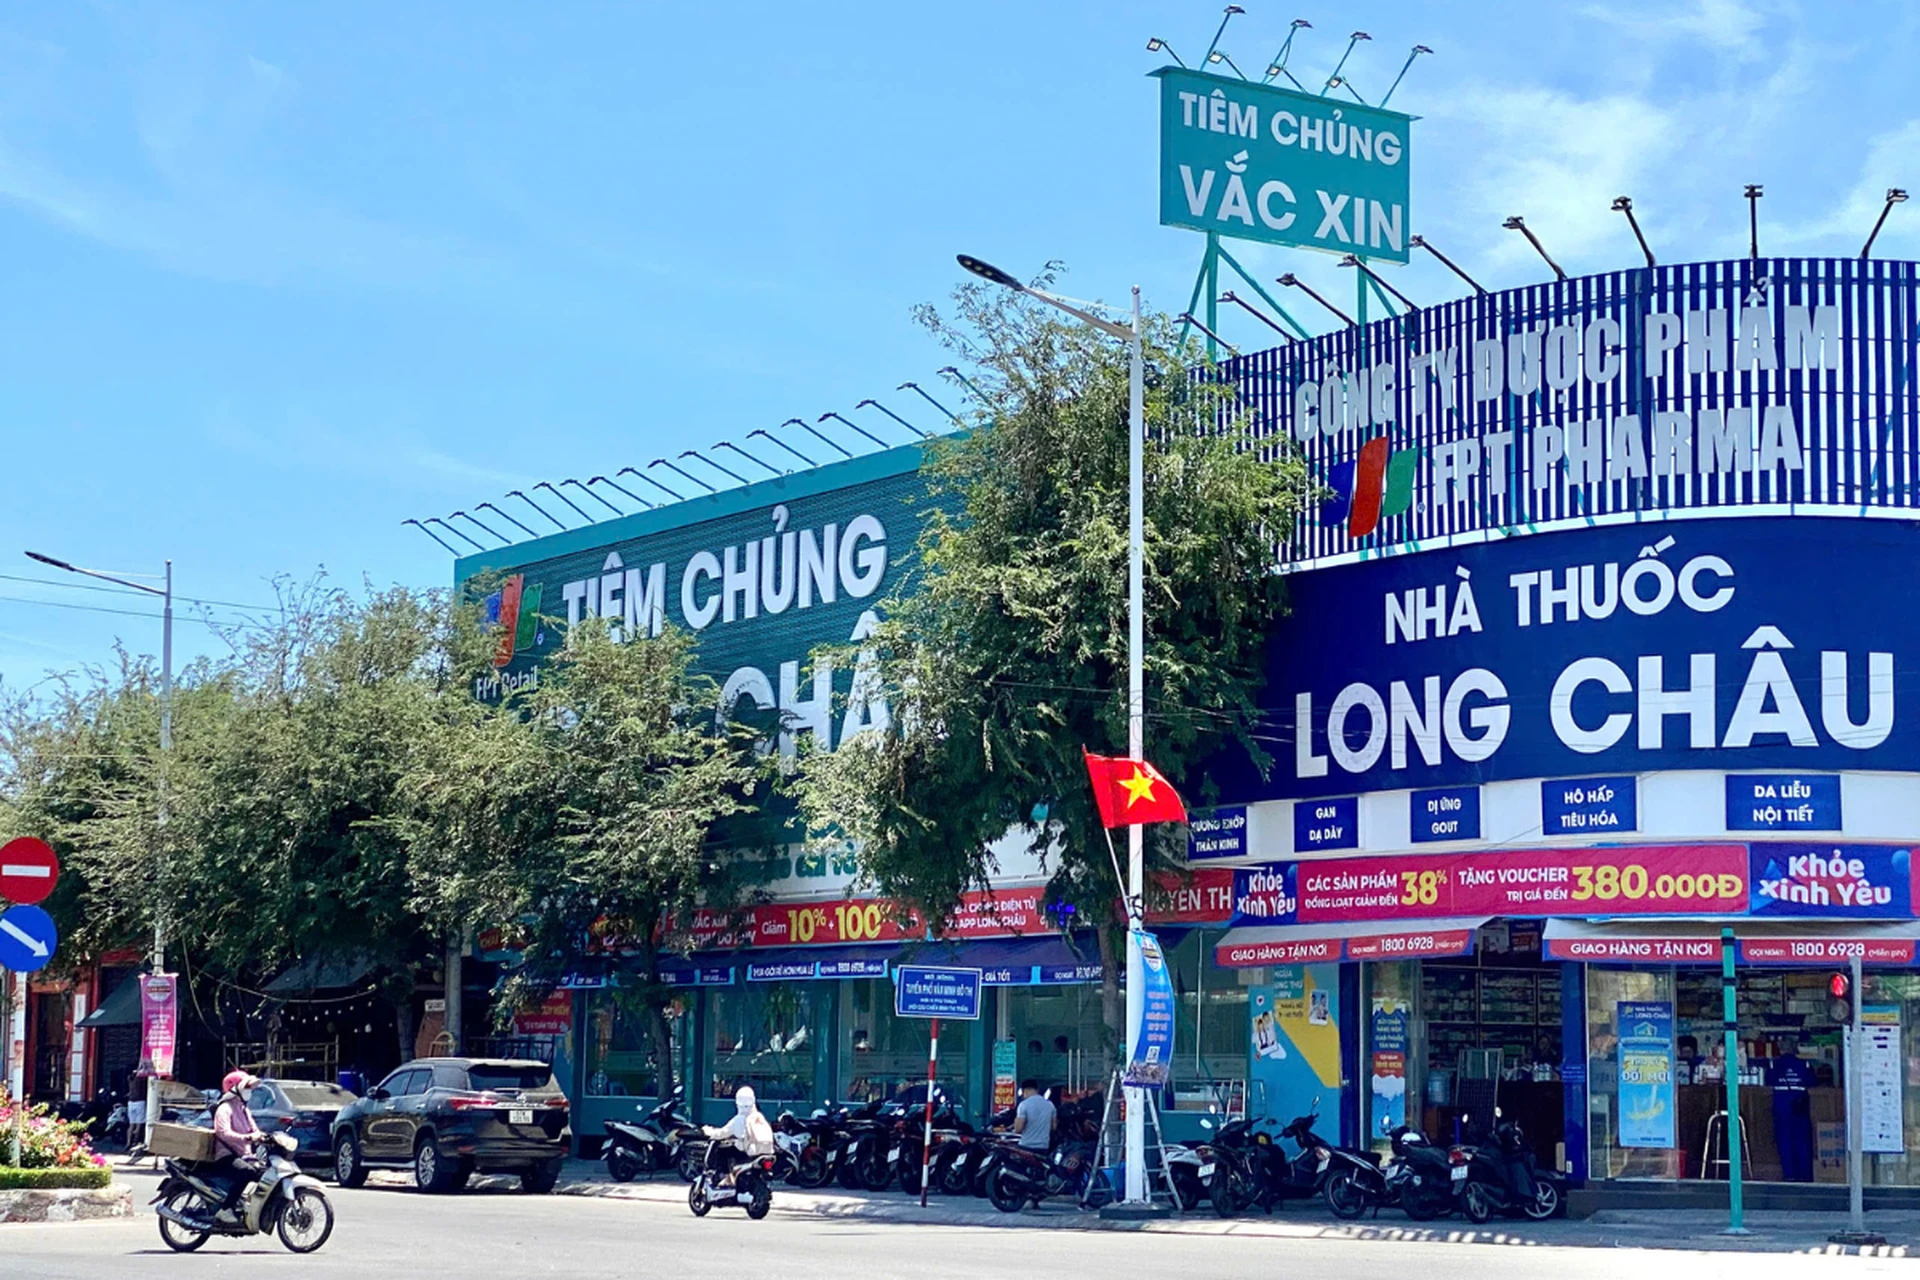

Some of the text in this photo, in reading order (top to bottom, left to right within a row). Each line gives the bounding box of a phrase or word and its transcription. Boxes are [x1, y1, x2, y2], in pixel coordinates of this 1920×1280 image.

[1178, 89, 1401, 166] TIÊM CHỦNG
[1179, 149, 1402, 252] VẮC XIN
[1294, 276, 1839, 442] CÔNG TY DƯỢC PHẨM
[1434, 405, 1803, 507] FPT PHARMA
[562, 504, 888, 644] TIÊM CHỦNG
[1385, 535, 1736, 645] NHÀ THUỐC
[1296, 625, 1894, 778] LONG CHÂU
[1564, 784, 1615, 804] HÔ HẤP
[1754, 784, 1777, 798] DA
[1316, 806, 1336, 819] GAN
[1428, 800, 1438, 815] DỊ
[1561, 810, 1618, 828] TIÊU HÓA
[1753, 803, 1815, 825] NỘI TIẾT
[1309, 826, 1343, 844] DẠ DÀY
[1432, 820, 1458, 834] GOUT
[1789, 849, 1865, 879] Khỏe
[1249, 866, 1283, 893] Khỏe
[1306, 868, 1398, 892] CÁC SẢN PHẨM
[1400, 869, 1448, 906] 38%
[1458, 866, 1569, 888] TẶNG VOUCHER
[1269, 890, 1296, 916] Yêu
[1506, 887, 1568, 904] TRỊ GIÁ ĐẾN
[1836, 879, 1892, 907] Yêu
[762, 920, 787, 935] Giảm
[788, 908, 827, 942] 10%
[1231, 944, 1327, 961] GIAO HÀNG TẬN NƠI
[1381, 938, 1406, 953] 1800
[1407, 936, 1434, 950] 6928
[1570, 941, 1713, 958] GIAO HÀNG TẬN NƠI
[1790, 942, 1825, 956] 1800
[1828, 942, 1865, 956] 6928
